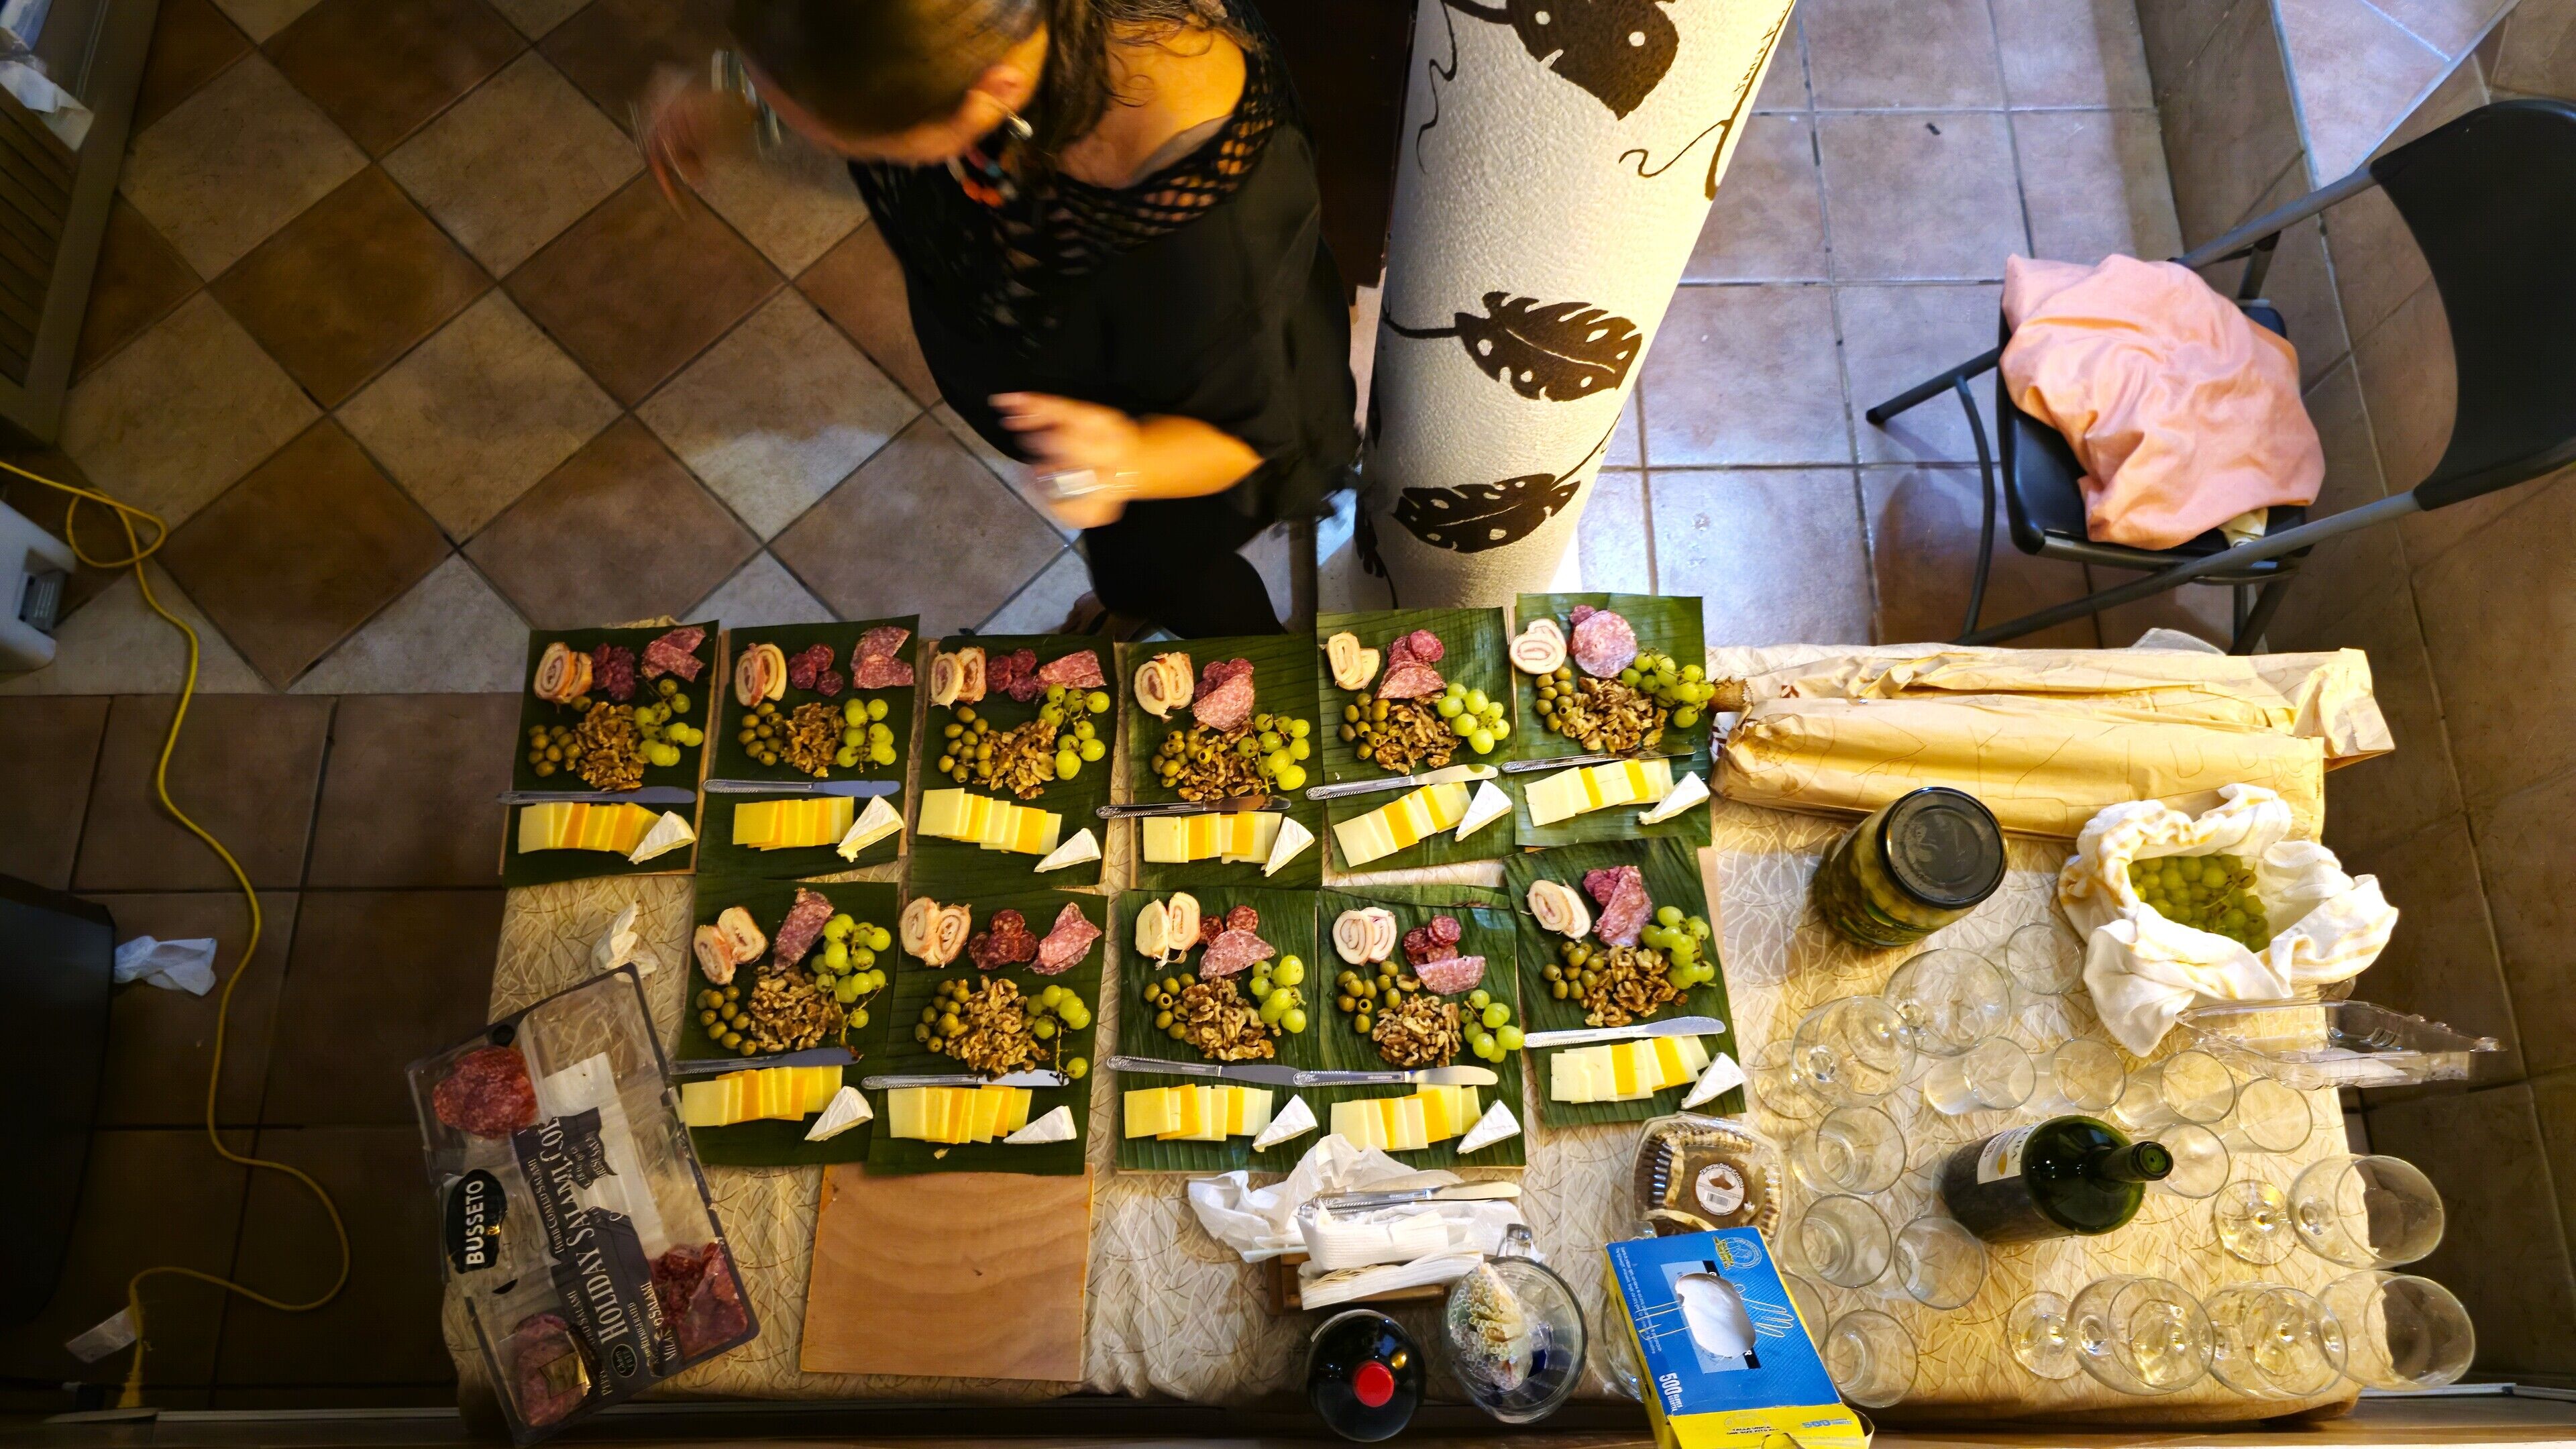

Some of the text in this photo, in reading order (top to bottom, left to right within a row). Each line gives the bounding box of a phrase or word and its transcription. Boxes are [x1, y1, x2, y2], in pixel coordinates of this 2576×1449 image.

[527, 1157, 545, 1193] SALAMI
[465, 1179, 485, 1265] BUSSETO
[575, 1246, 629, 1344] HOLIDAY
[639, 1281, 661, 1319] SALAMI
[1659, 1373, 1682, 1396] 500
